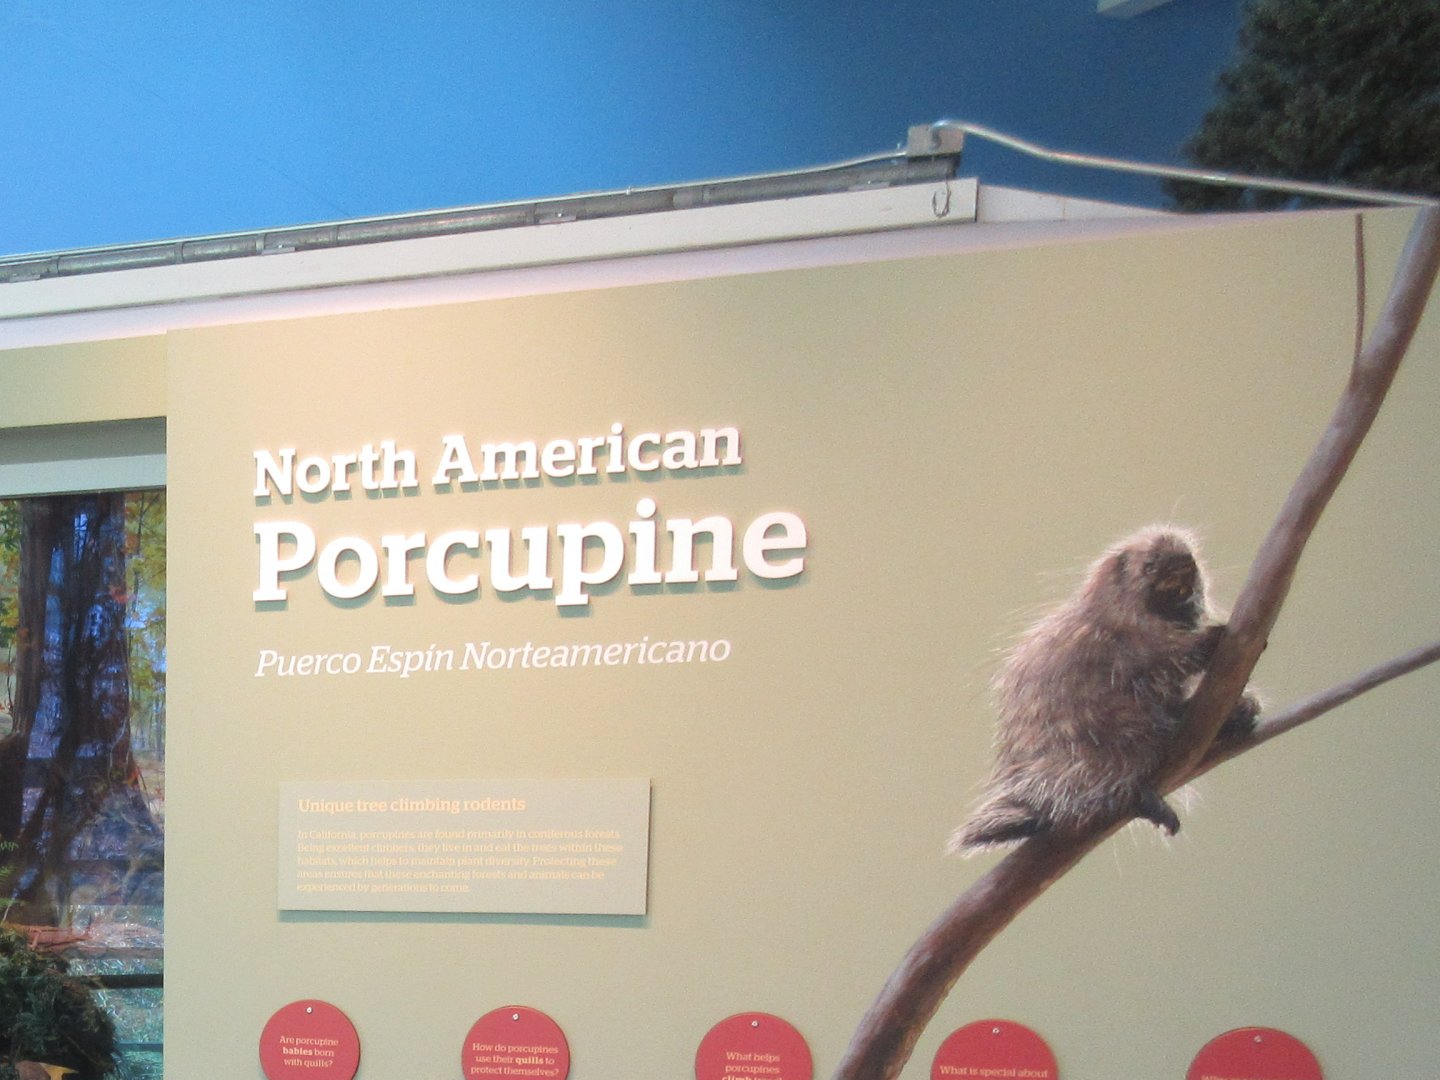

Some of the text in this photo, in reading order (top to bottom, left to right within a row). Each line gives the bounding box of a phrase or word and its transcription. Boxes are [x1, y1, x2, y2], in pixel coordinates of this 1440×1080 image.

[253, 423, 742, 498] North American
[252, 497, 807, 606] Porcupine
[255, 635, 732, 679] Puerco Espín Norteamericano
[298, 797, 527, 815] Unique tree climbing rodents
[434, 829, 465, 839] found
[279, 1035, 339, 1046] Are porcupine
[282, 1047, 335, 1057] babies born
[472, 1043, 559, 1054] How do porcupines
[284, 1057, 334, 1068] with quills?
[493, 1055, 514, 1063] their
[515, 1056, 544, 1065] quills
[545, 1057, 555, 1065] to
[726, 1051, 780, 1063] What helps
[470, 1067, 560, 1077] protect themselves?
[725, 1065, 780, 1074] porcupines
[940, 1066, 1048, 1078] What is special about
